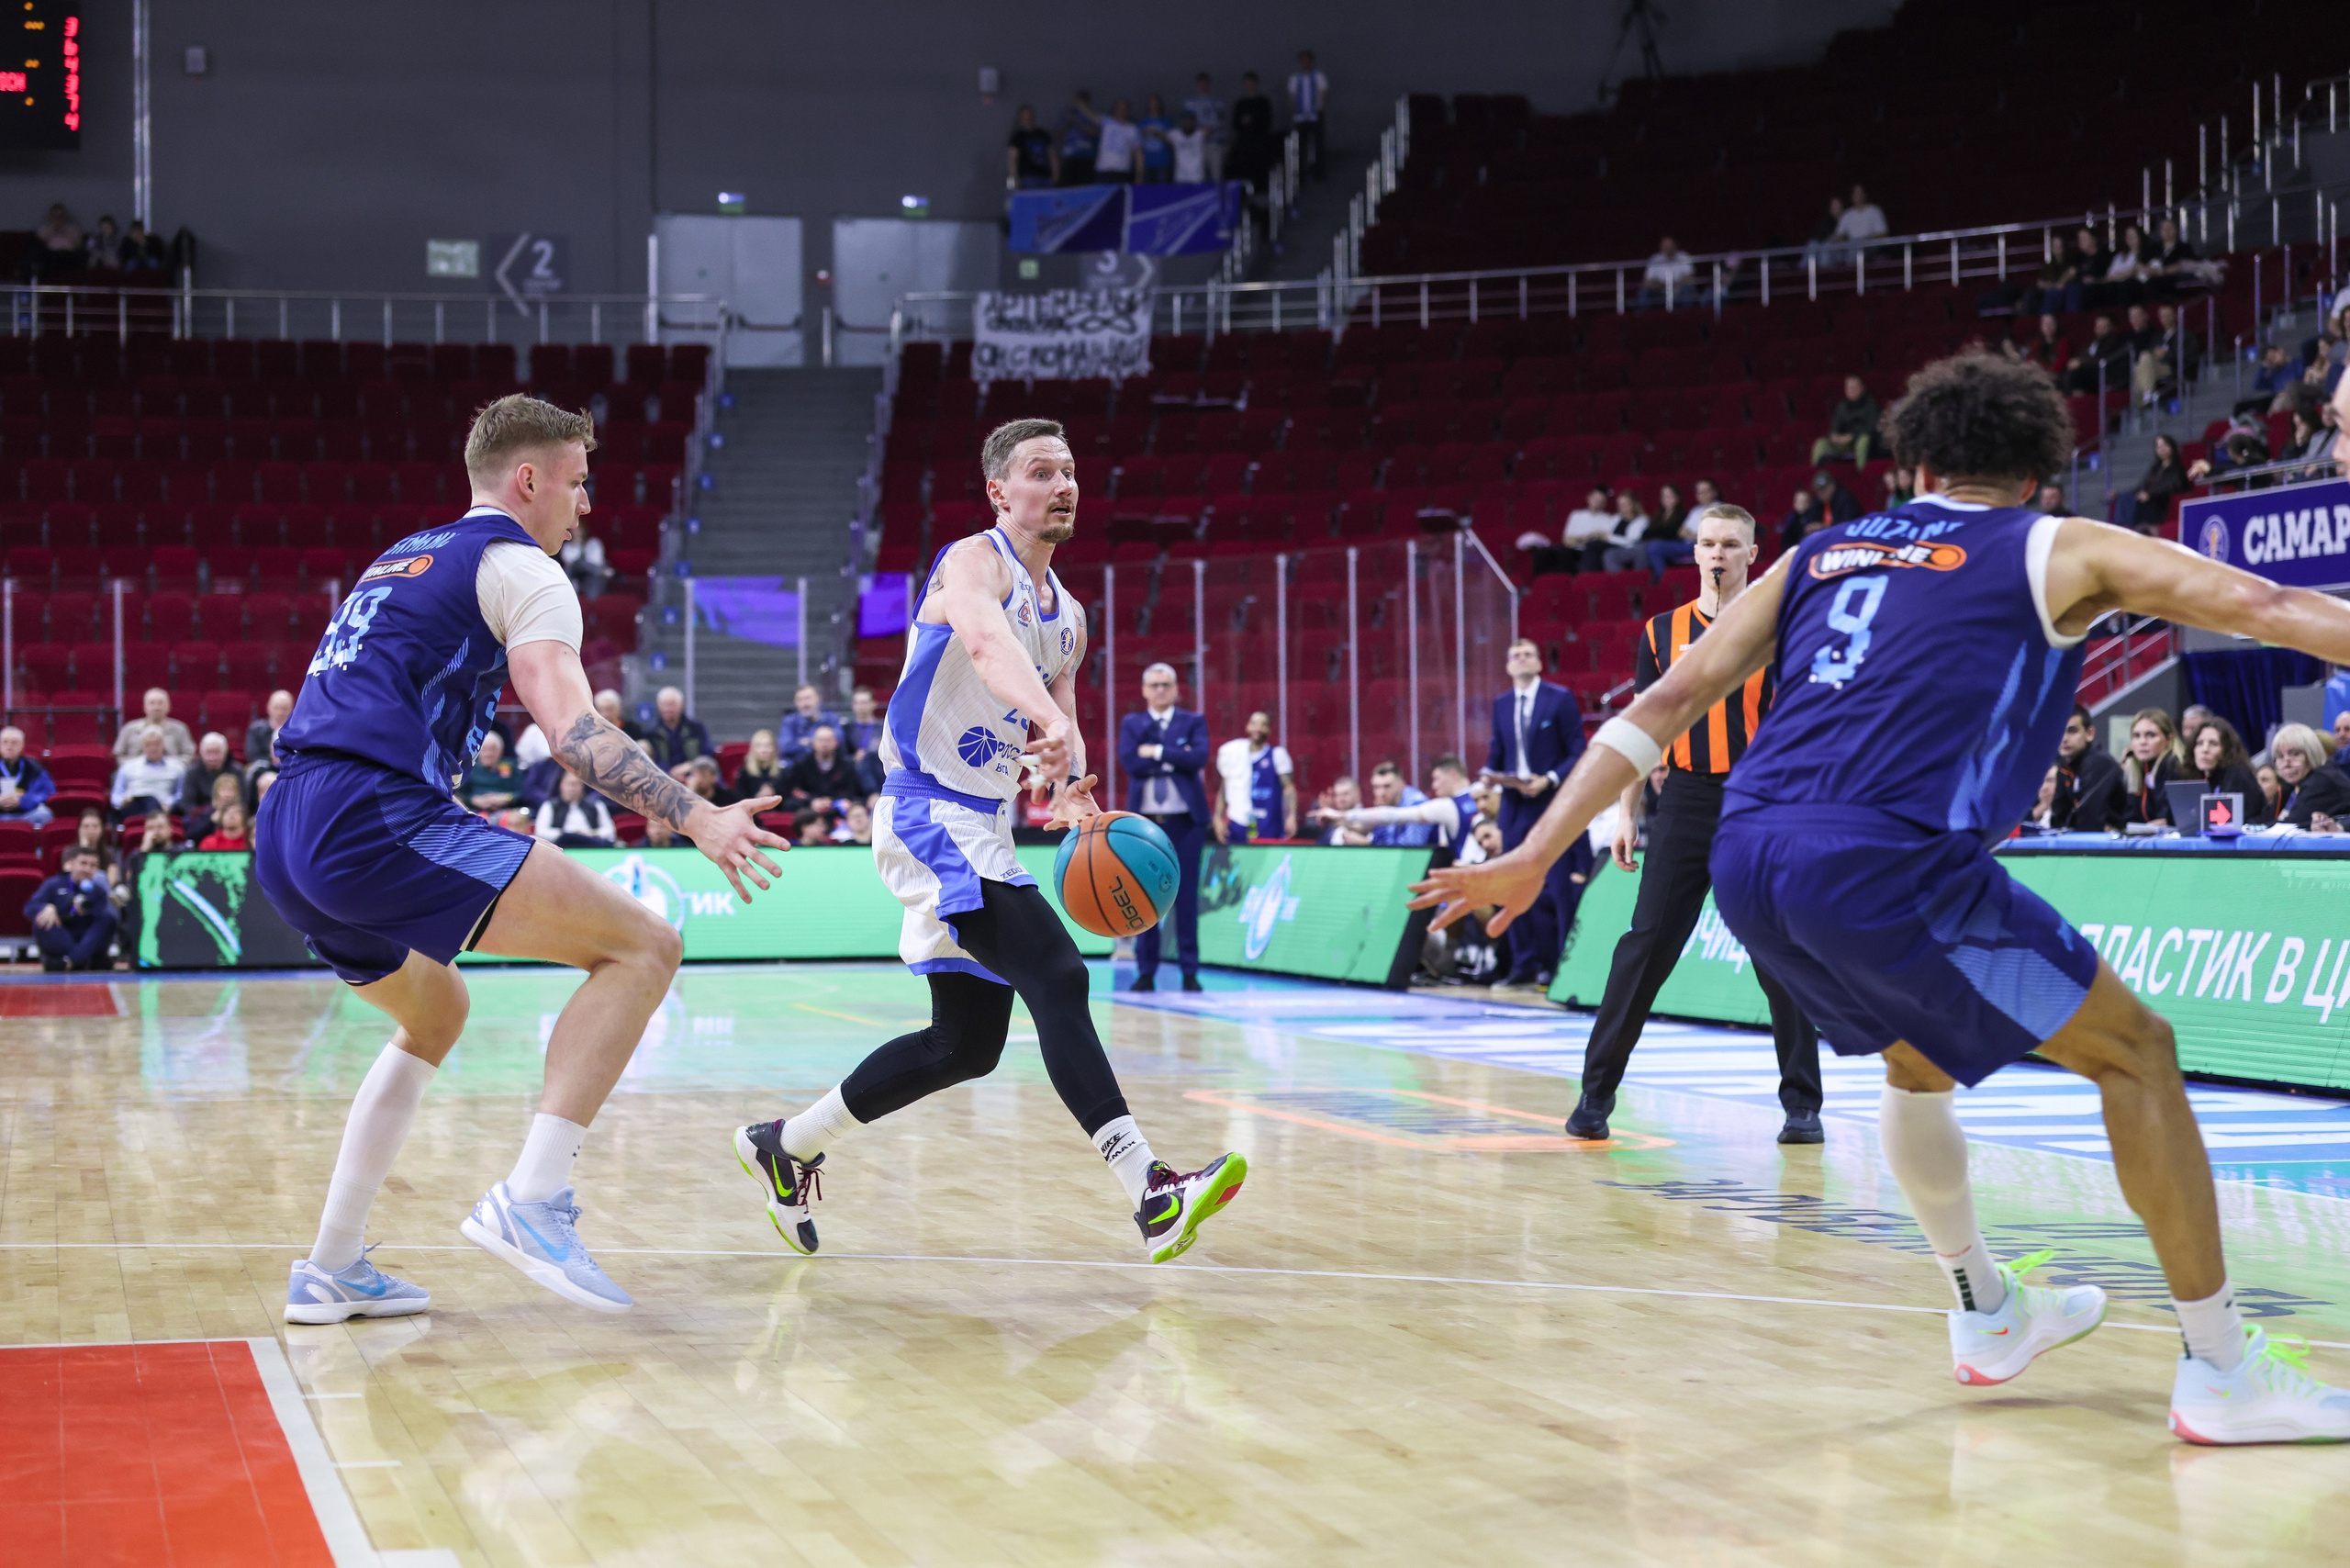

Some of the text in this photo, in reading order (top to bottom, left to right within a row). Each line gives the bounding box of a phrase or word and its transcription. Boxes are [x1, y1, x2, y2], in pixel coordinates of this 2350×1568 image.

[532, 240, 554, 276] 2
[1811, 575, 1889, 689] 9
[1110, 875, 1147, 932] ÖGEL
[2263, 936, 2305, 1005] В
[1101, 1132, 1121, 1154] NIKE
